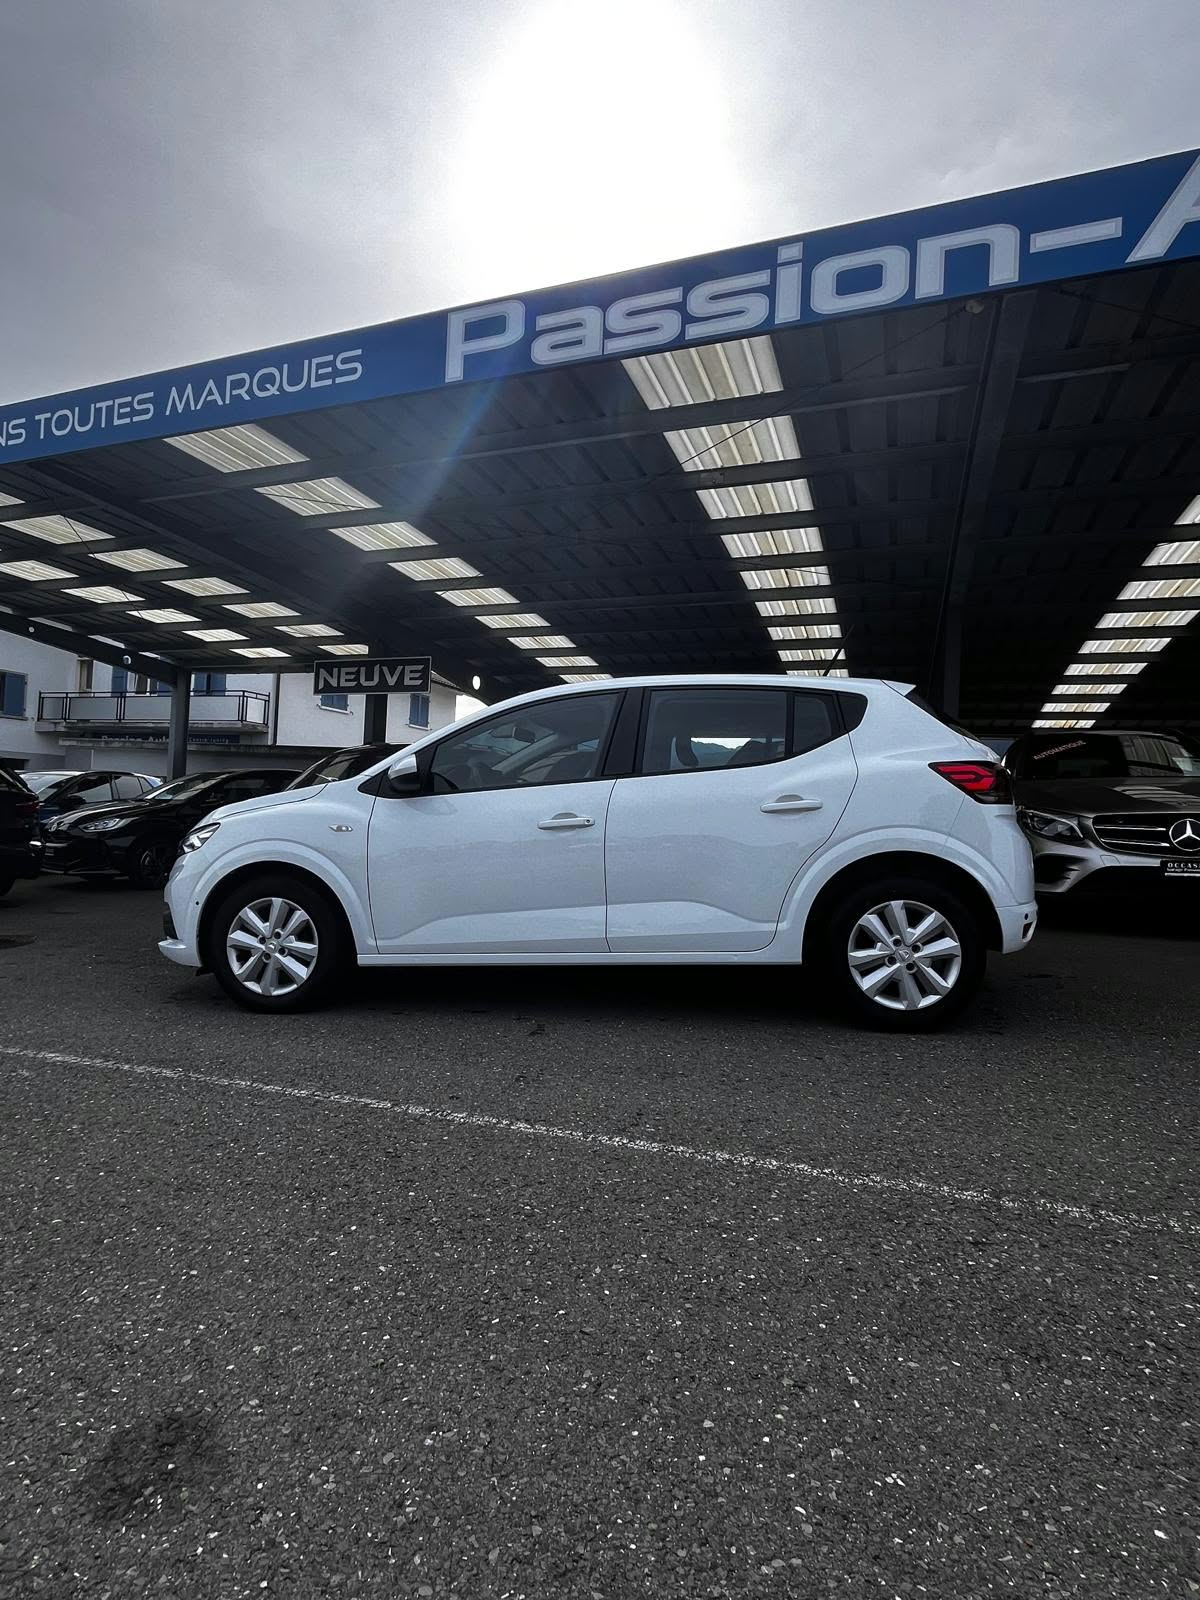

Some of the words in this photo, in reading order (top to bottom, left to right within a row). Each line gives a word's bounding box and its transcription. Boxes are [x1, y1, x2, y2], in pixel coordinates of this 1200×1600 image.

[35, 391, 154, 440] TOUTES
[165, 349, 363, 415] MARQUES
[318, 664, 425, 690] NEUVE
